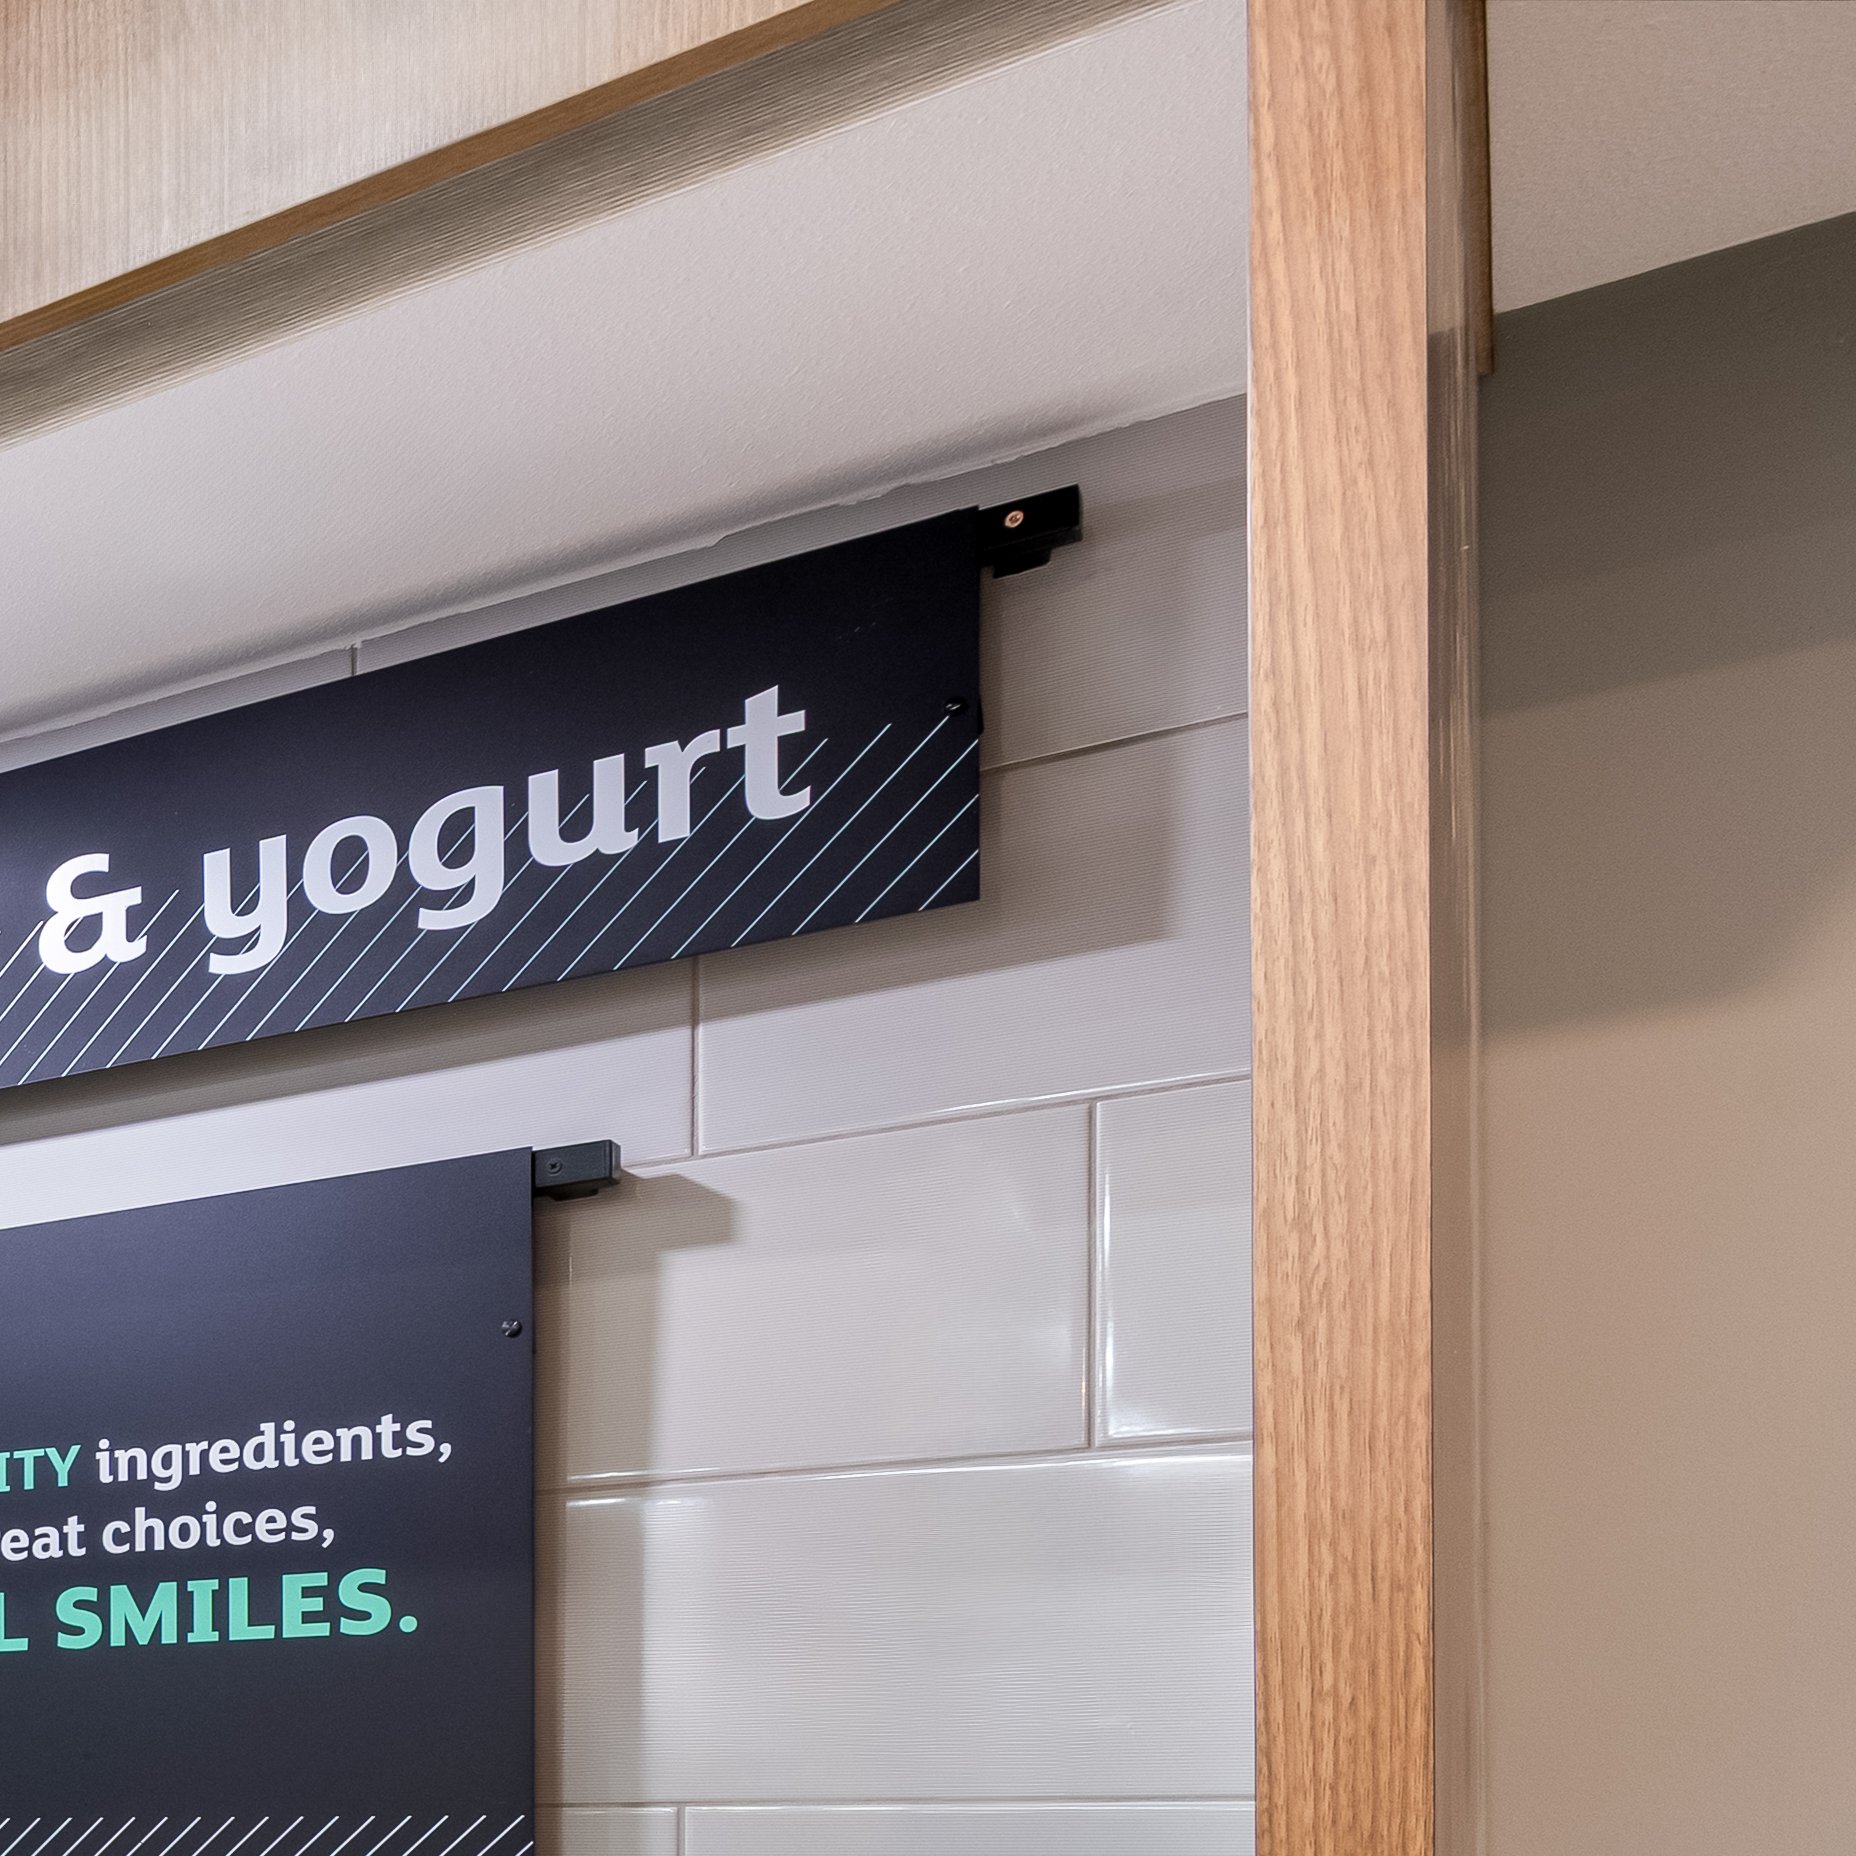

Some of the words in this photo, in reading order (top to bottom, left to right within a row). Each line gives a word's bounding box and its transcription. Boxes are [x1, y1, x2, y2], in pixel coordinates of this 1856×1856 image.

[40, 852, 147, 974] &
[201, 685, 814, 974] yogurt
[96, 1413, 453, 1492] ingredients,
[102, 1502, 336, 1554] choices,
[55, 1568, 419, 1652] SMILES.
